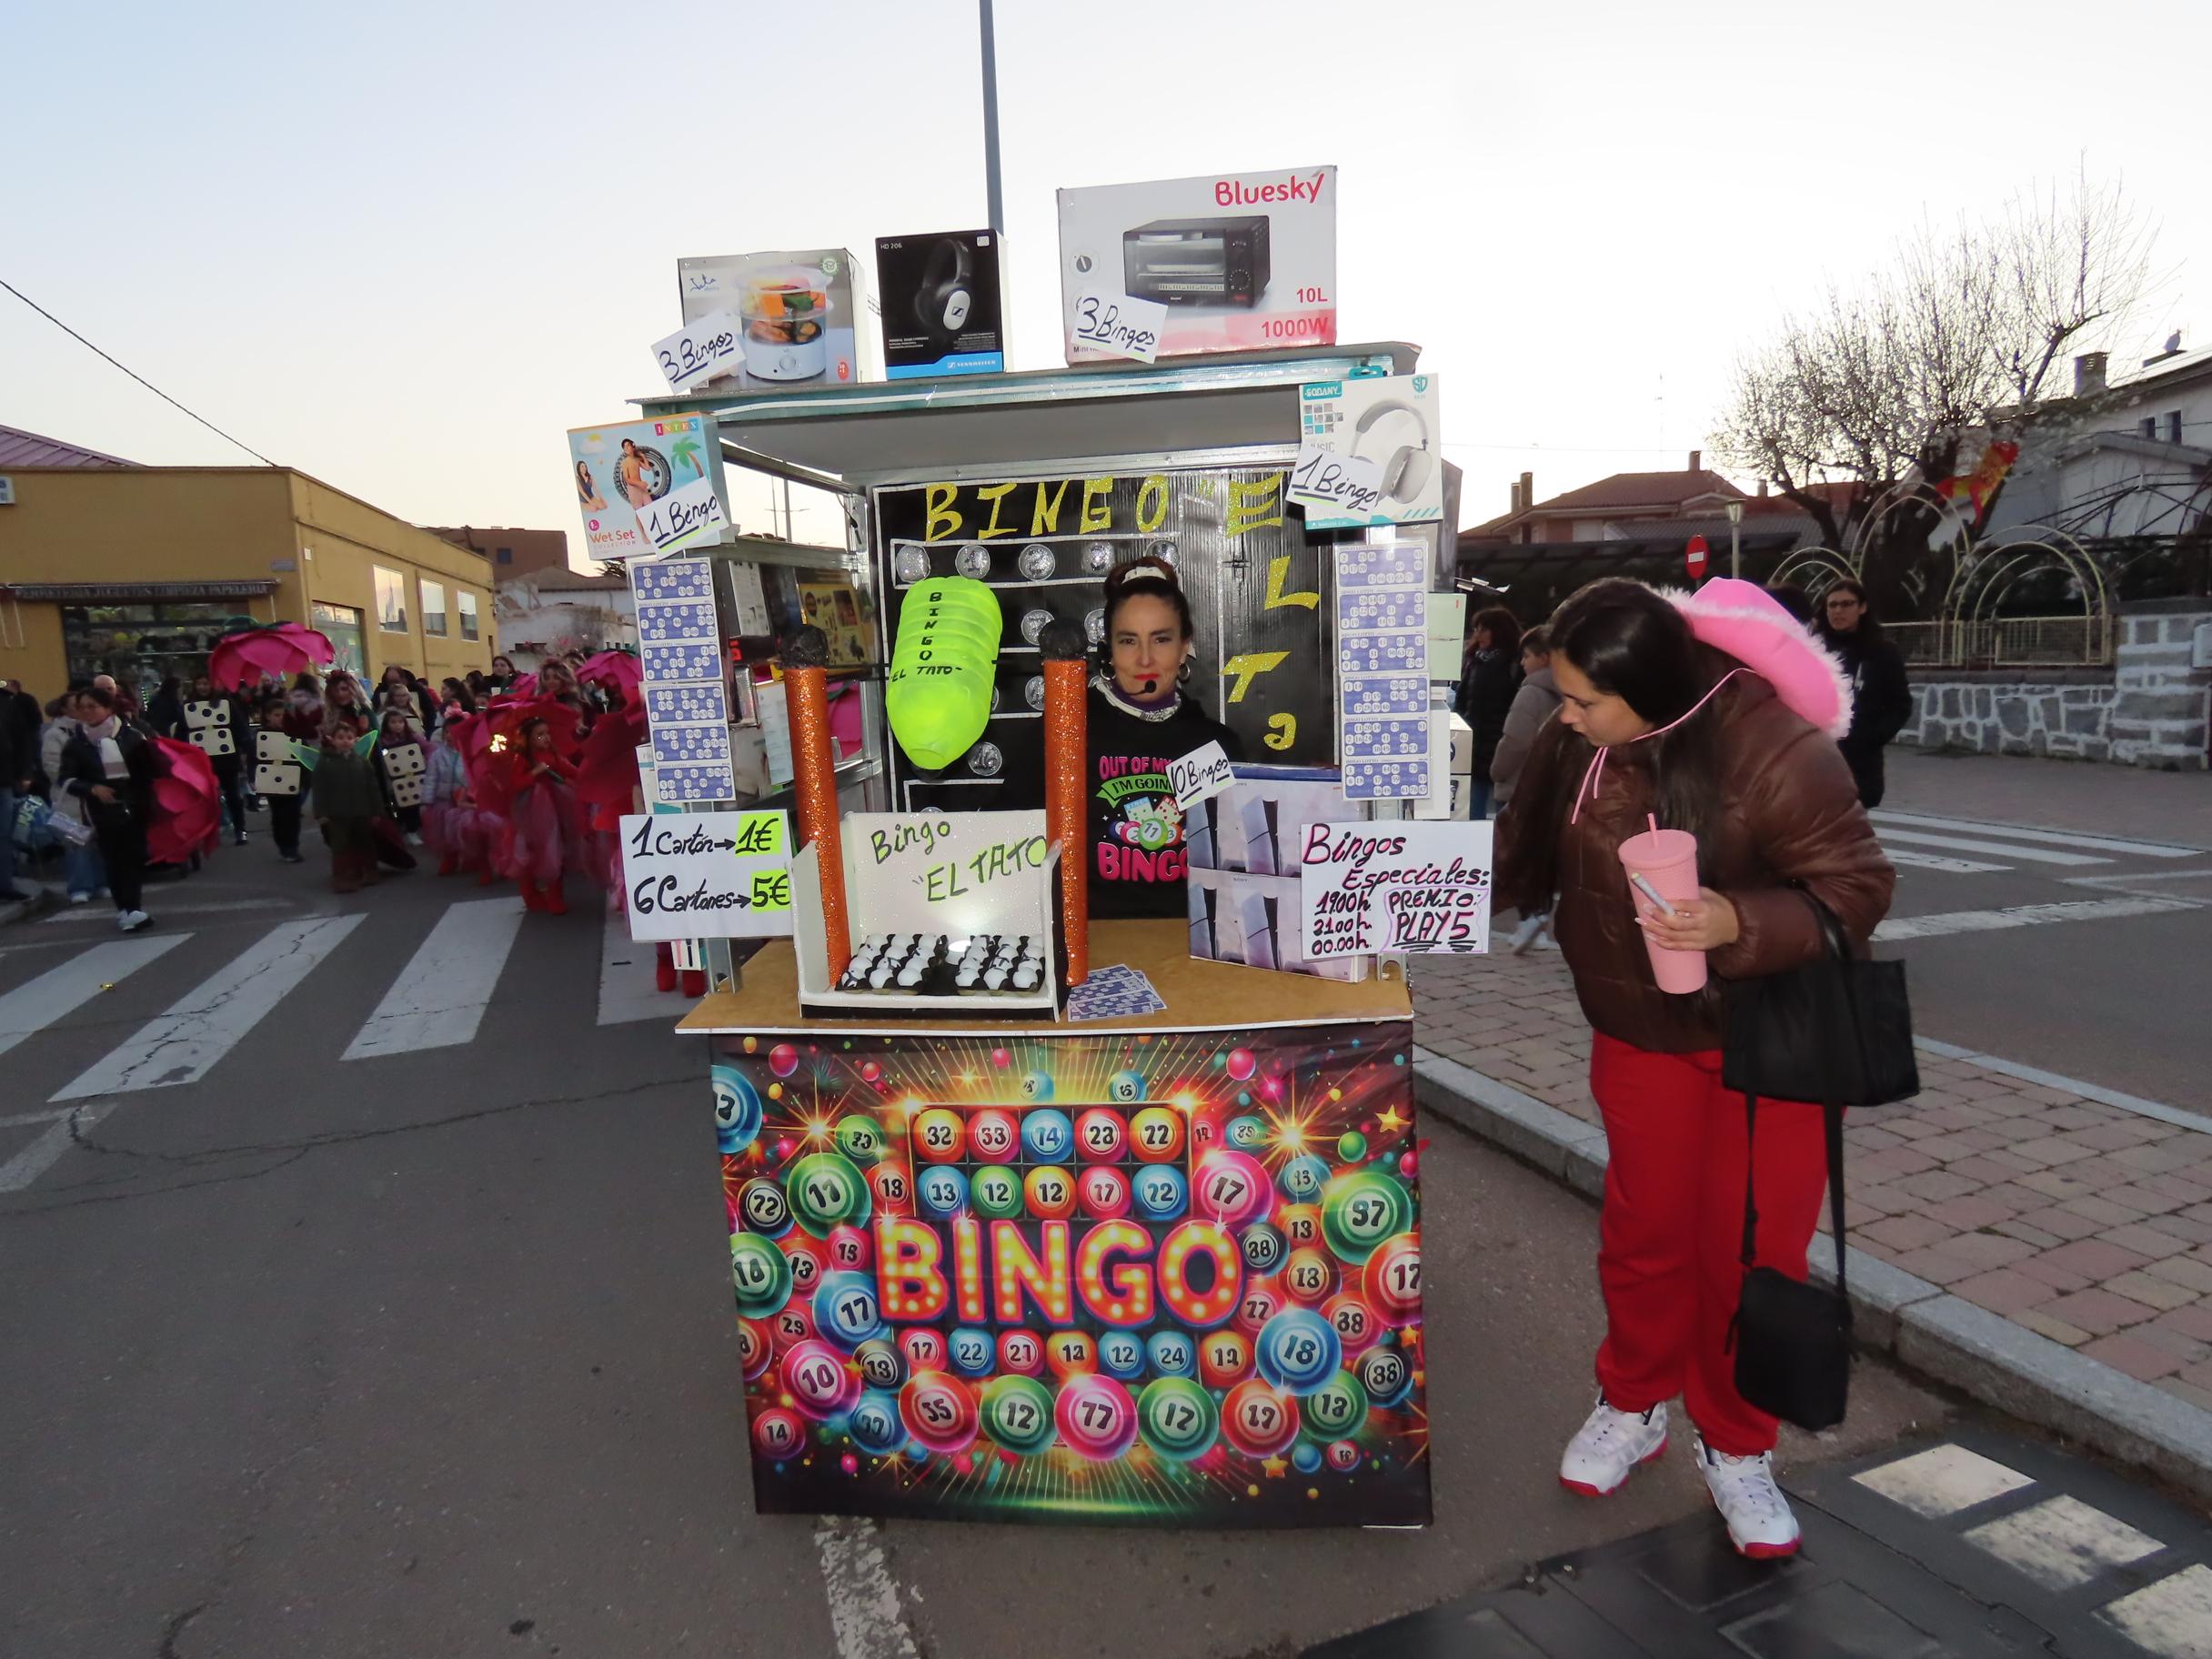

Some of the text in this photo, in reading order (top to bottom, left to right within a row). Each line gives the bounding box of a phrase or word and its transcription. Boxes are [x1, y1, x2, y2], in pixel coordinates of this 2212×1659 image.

[1214, 173, 1325, 206] Bluesky
[1296, 287, 1329, 305] 10L
[1077, 297, 1155, 350] 3 Bingos
[1262, 317, 1329, 338] 1000W
[659, 332, 733, 380] 3 Bingos
[656, 422, 698, 434] INTEX
[1292, 453, 1378, 508] 1 Bingo
[926, 474, 1169, 543] BINGO
[589, 529, 636, 543] Wet Set
[650, 512, 670, 543] 1
[919, 592, 942, 661] BINGO
[1099, 755, 1129, 779] OUT
[1131, 756, 1151, 774] OF
[1170, 758, 1229, 797] 10 Bingos
[1111, 780, 1133, 794] I'M
[632, 816, 779, 859] 1 Cartón 1€
[871, 820, 951, 864] Bingo
[1302, 823, 1407, 868] Bingos
[1342, 857, 1491, 896] Especiales:
[633, 874, 791, 914] 6 Cartones 5€
[1389, 888, 1482, 913] PREMIO:
[1395, 911, 1475, 942] PLAY 5
[928, 1126, 951, 1146] 32
[988, 1184, 1009, 1202] 12
[1040, 1183, 1062, 1202] 12
[1212, 1176, 1244, 1205] 17
[874, 1218, 1242, 1325] BINGO
[841, 1296, 869, 1326] 17
[960, 1343, 981, 1360] 22
[1161, 1348, 1184, 1364] 24
[1283, 1335, 1316, 1365] 18
[802, 1364, 834, 1394] 10
[1007, 1402, 1035, 1429] 12
[1081, 1402, 1112, 1429] 77
[766, 1423, 787, 1442] 14
